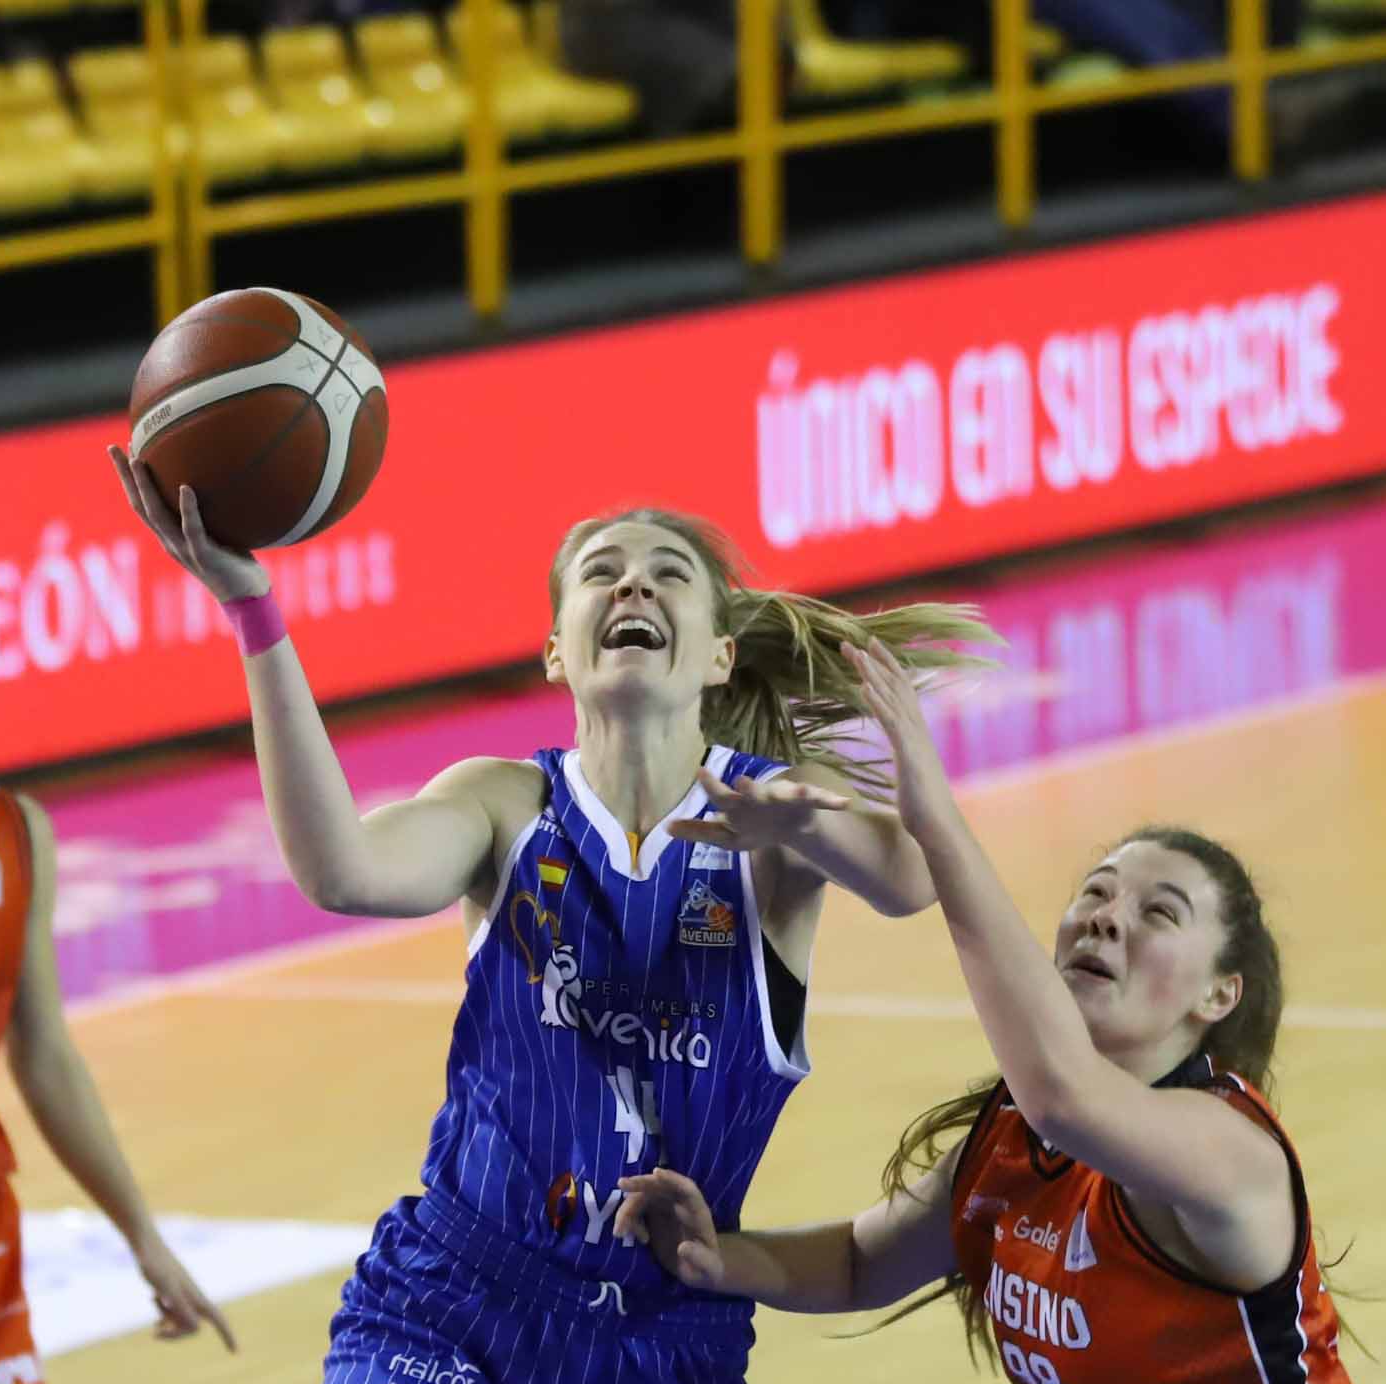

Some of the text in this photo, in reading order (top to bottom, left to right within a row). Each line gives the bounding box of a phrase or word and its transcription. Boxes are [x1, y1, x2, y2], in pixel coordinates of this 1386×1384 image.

[755, 348, 944, 549] ÚNICO
[950, 341, 1034, 506] EN
[1037, 330, 1124, 490] SU
[680, 927, 734, 945] AVENIDA
[1013, 1215, 1062, 1255] Galé
[984, 1261, 1093, 1350] NSINO
